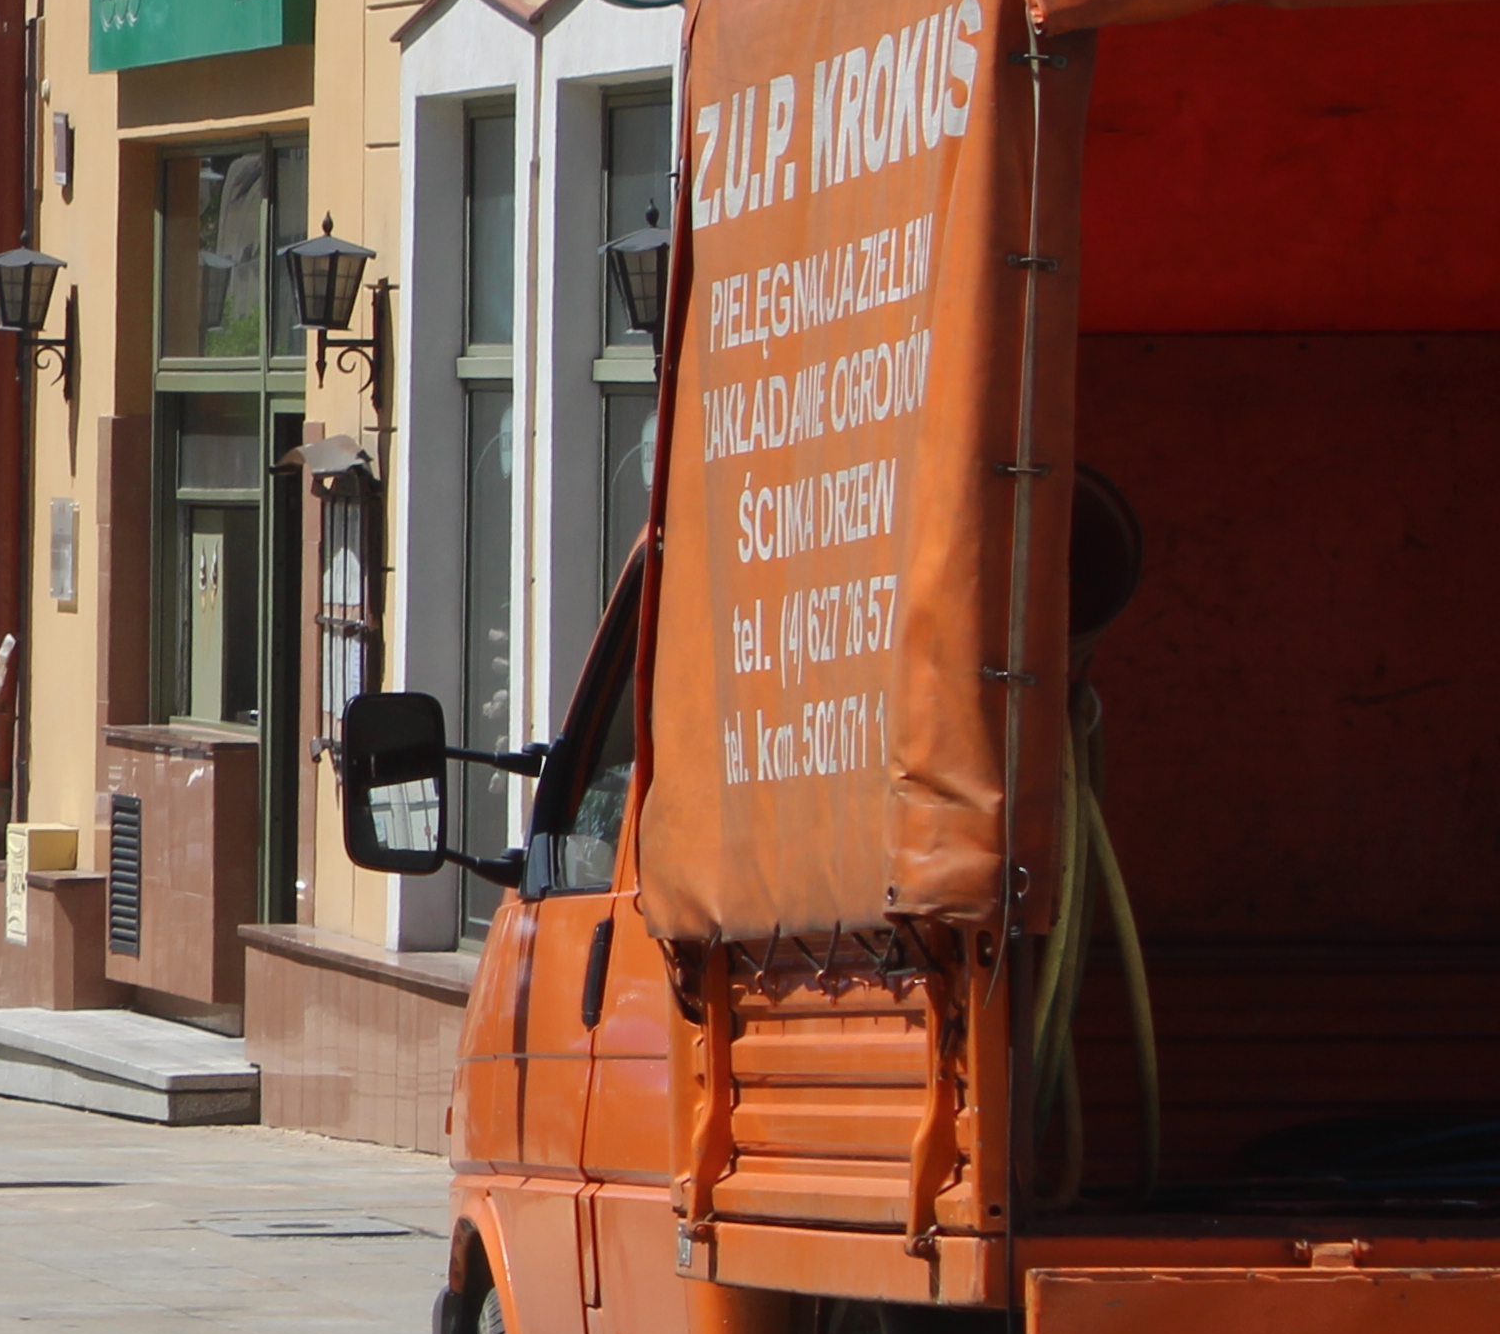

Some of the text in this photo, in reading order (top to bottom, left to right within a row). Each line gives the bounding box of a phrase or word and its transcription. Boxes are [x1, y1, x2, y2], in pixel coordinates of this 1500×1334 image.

[692, 72, 797, 231] Z.U.P.
[709, 242, 855, 361] PIELĘGNACJA
[703, 361, 826, 464] ZAKŁADANIE
[820, 457, 897, 548] DRZEW
[733, 597, 772, 674] tel.
[807, 585, 841, 664] 627
[867, 573, 898, 653] 57
[724, 710, 750, 785] tel.
[802, 698, 838, 776] 502
[840, 692, 867, 773] 671
